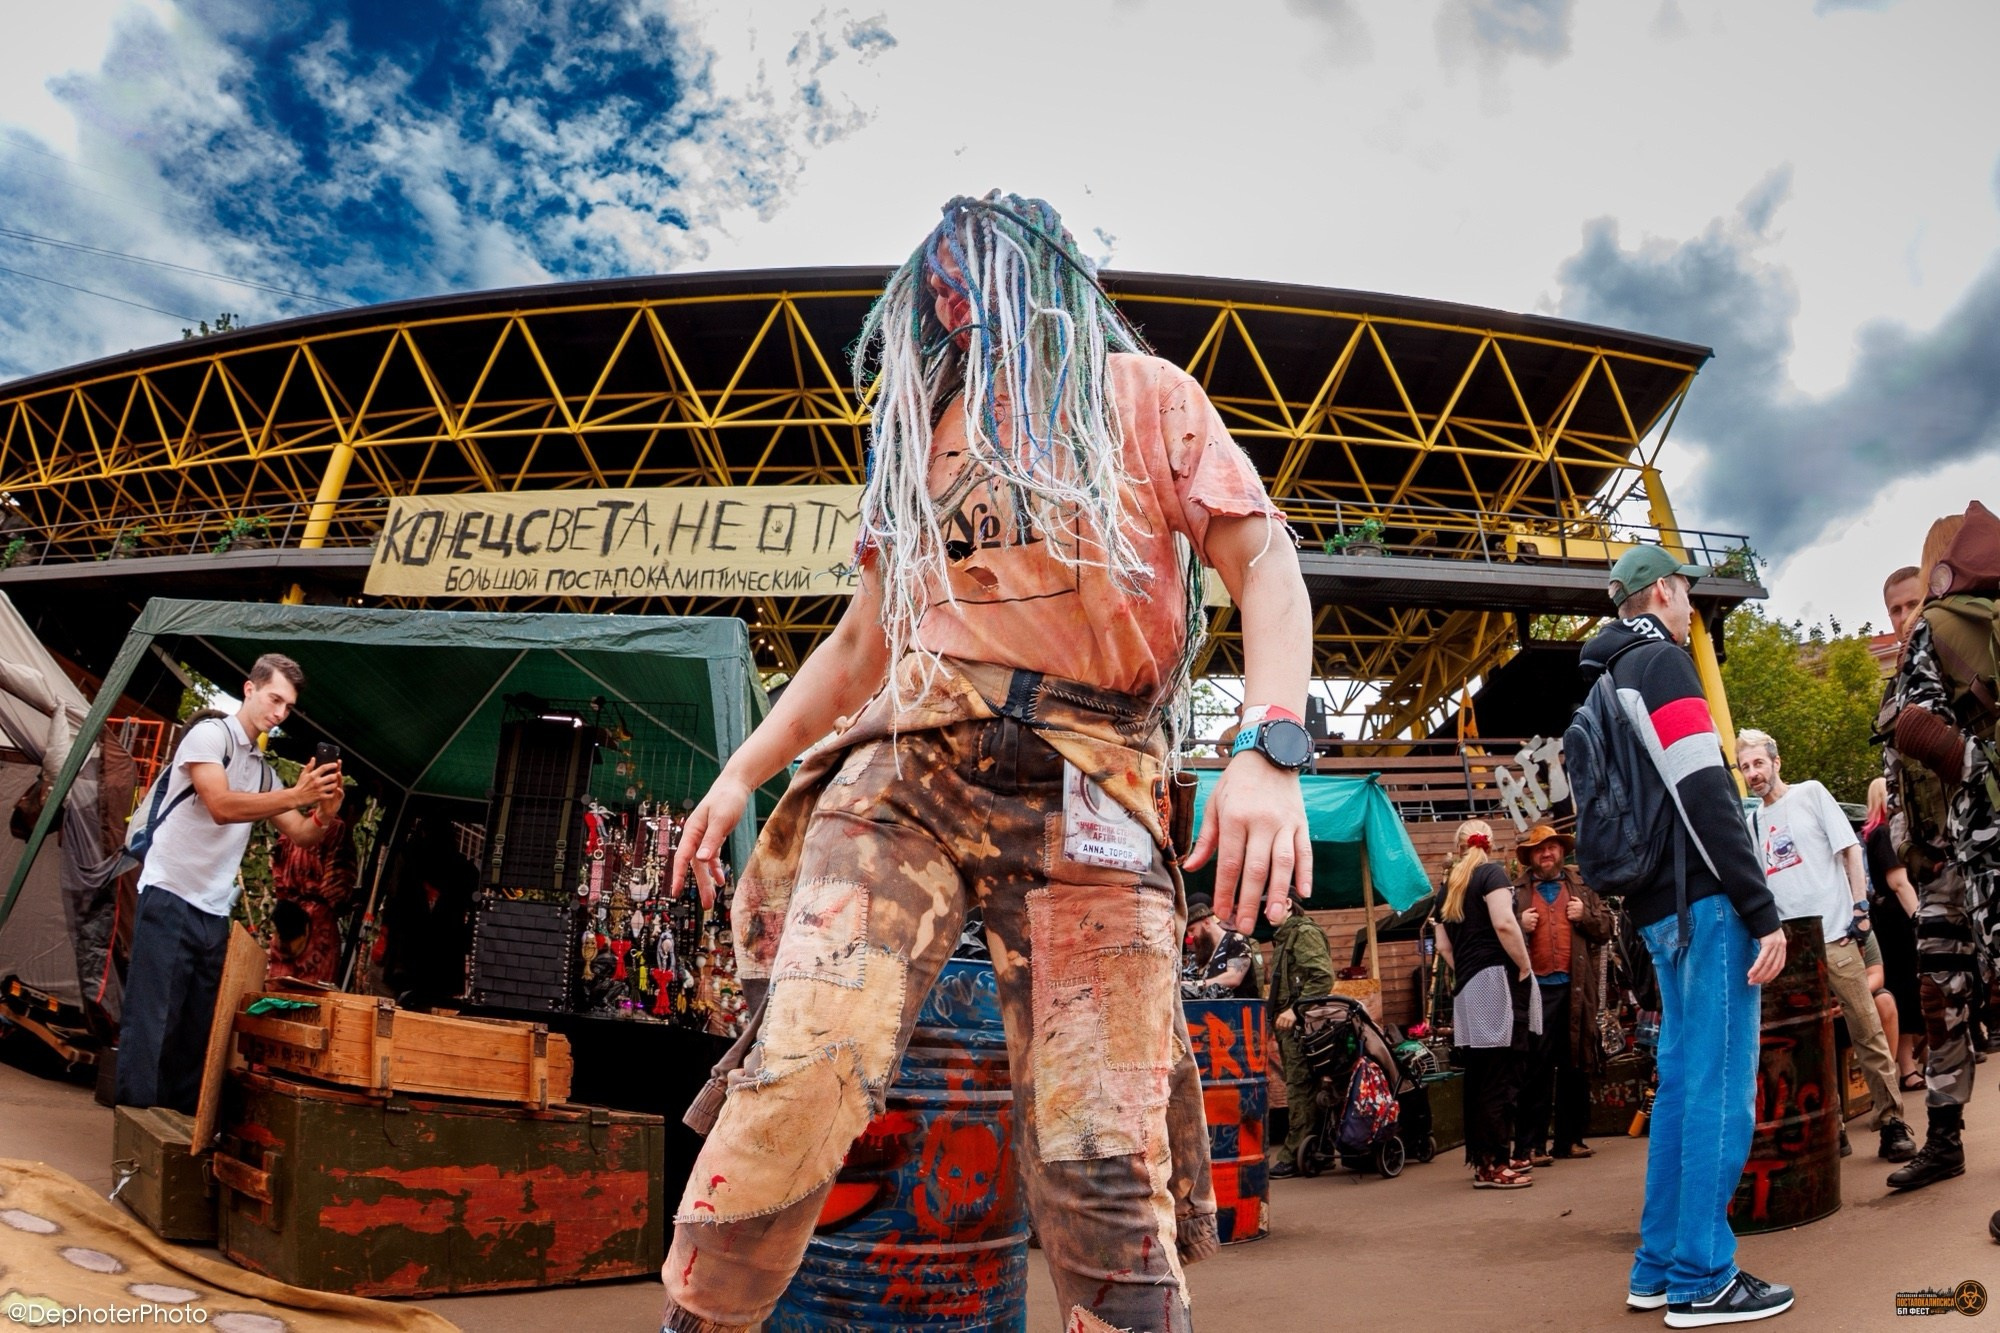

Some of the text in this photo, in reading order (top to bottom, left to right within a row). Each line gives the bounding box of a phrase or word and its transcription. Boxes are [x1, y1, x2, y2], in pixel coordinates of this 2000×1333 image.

[445, 565, 541, 593] БОЛЬШОЙ
[545, 564, 811, 592] ПОСТАПОКАЛИПТИЧЕСКИЙ
[1093, 832, 1127, 845] AFTER US
[1083, 844, 1133, 859] ANNA_TOPOR
